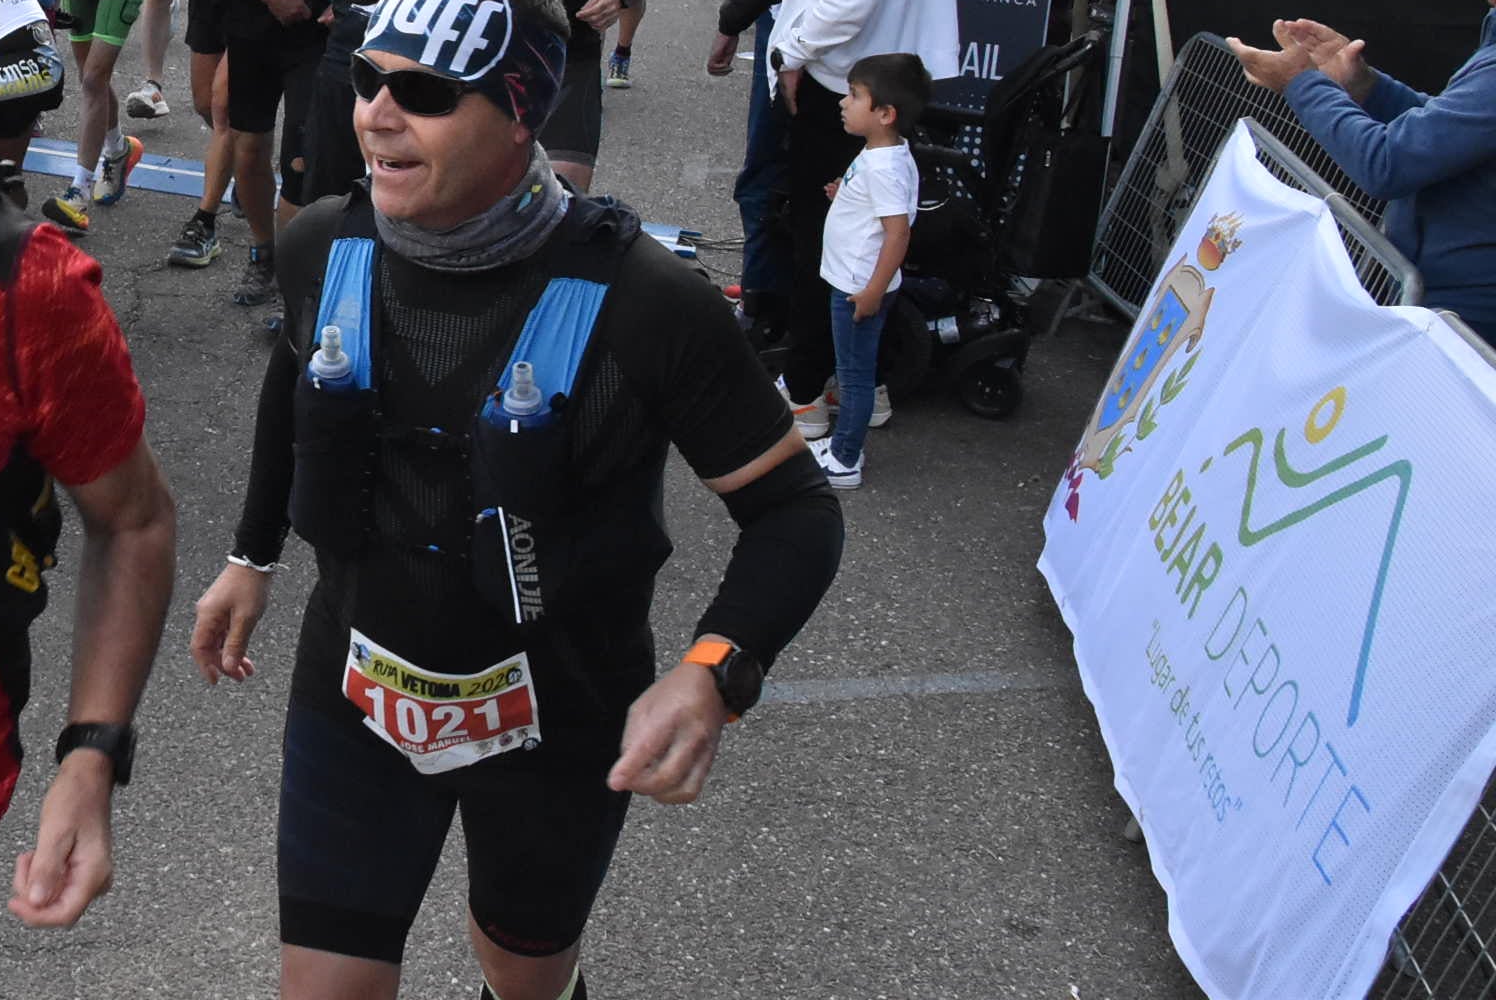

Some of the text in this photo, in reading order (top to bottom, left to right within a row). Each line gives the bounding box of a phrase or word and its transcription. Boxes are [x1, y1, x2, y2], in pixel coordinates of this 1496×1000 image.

[508, 513, 545, 621] AONIJIE
[372, 659, 399, 686] RUTA
[401, 669, 461, 699] VETONA
[365, 685, 502, 744] 1021
[1170, 684, 1191, 725] de
[400, 735, 473, 754] JOSE MANUEL
[1204, 586, 1371, 887] DEPORTE
